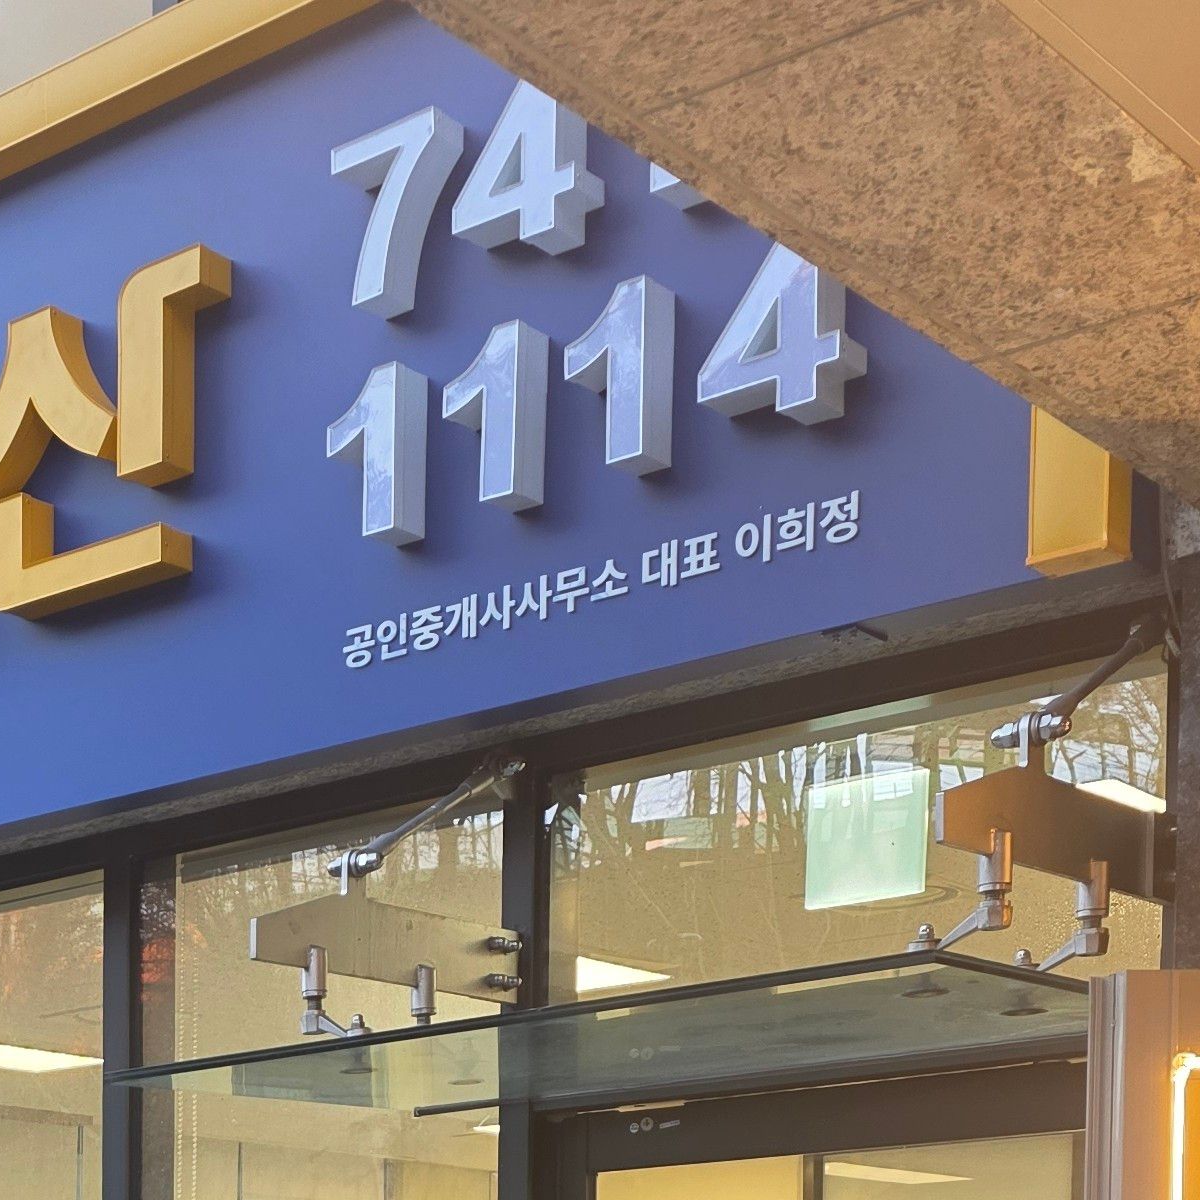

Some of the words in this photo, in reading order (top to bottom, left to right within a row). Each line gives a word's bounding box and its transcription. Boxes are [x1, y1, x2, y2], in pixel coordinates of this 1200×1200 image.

[330, 79, 706, 320] 74
[327, 242, 868, 547] 1114
[341, 557, 629, 669] 공인중개사사무소
[640, 531, 721, 588] 대표
[734, 490, 861, 563] 이희정
